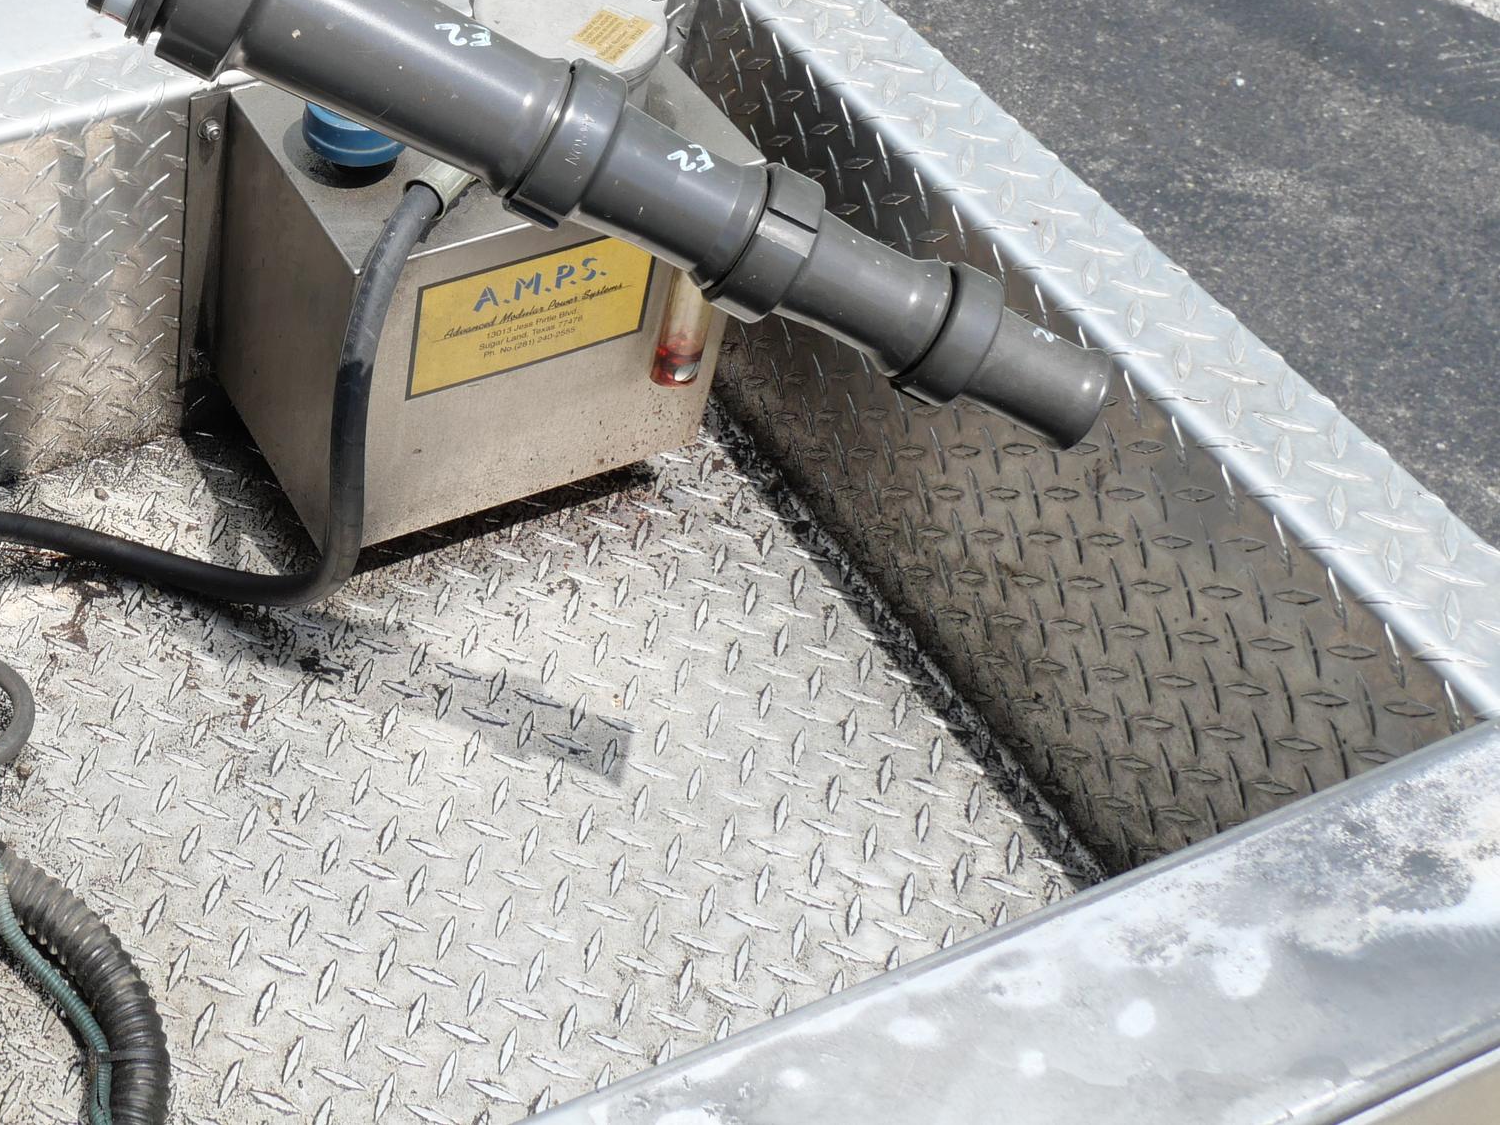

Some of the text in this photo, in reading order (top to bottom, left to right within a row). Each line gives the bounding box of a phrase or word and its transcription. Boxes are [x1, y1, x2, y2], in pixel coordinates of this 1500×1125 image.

[435, 24, 492, 47] E2
[667, 145, 715, 173] E2
[443, 283, 623, 339] Advanced Modular Power Systems
[479, 338, 504, 351] Sugar
[532, 323, 556, 335] Texas
[514, 321, 534, 332] Jess
